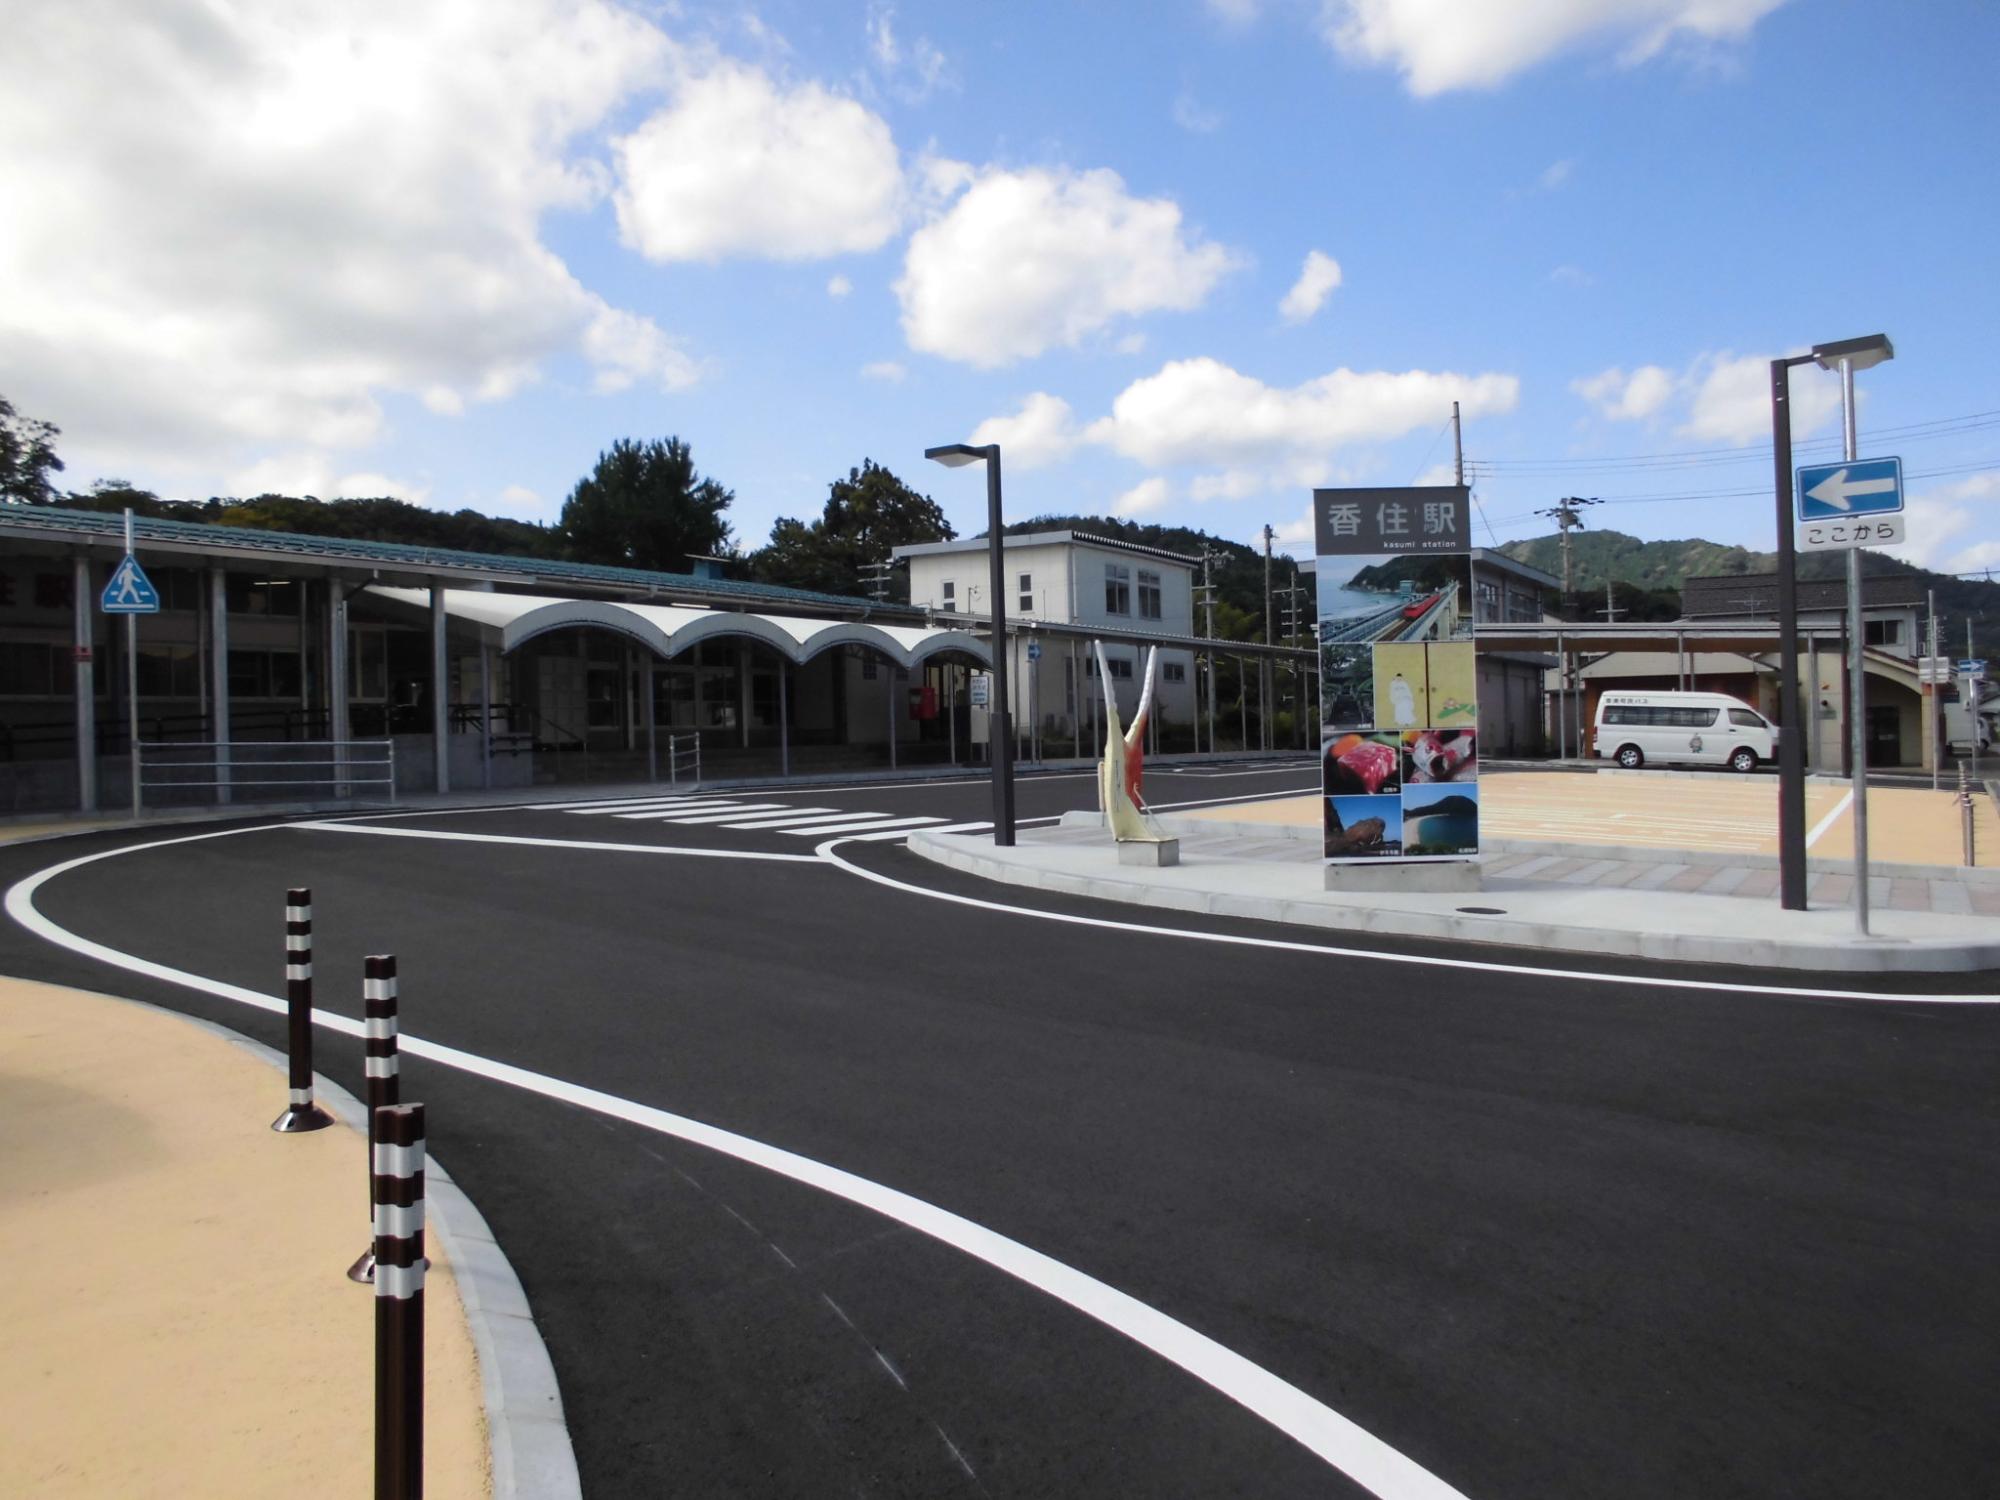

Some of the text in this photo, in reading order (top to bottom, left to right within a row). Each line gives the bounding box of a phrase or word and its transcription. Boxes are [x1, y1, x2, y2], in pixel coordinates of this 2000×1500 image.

[1328, 502, 1456, 536] 香住駅
[1808, 523, 1894, 544] ここから
[1383, 540, 1456, 549] kasumi station
